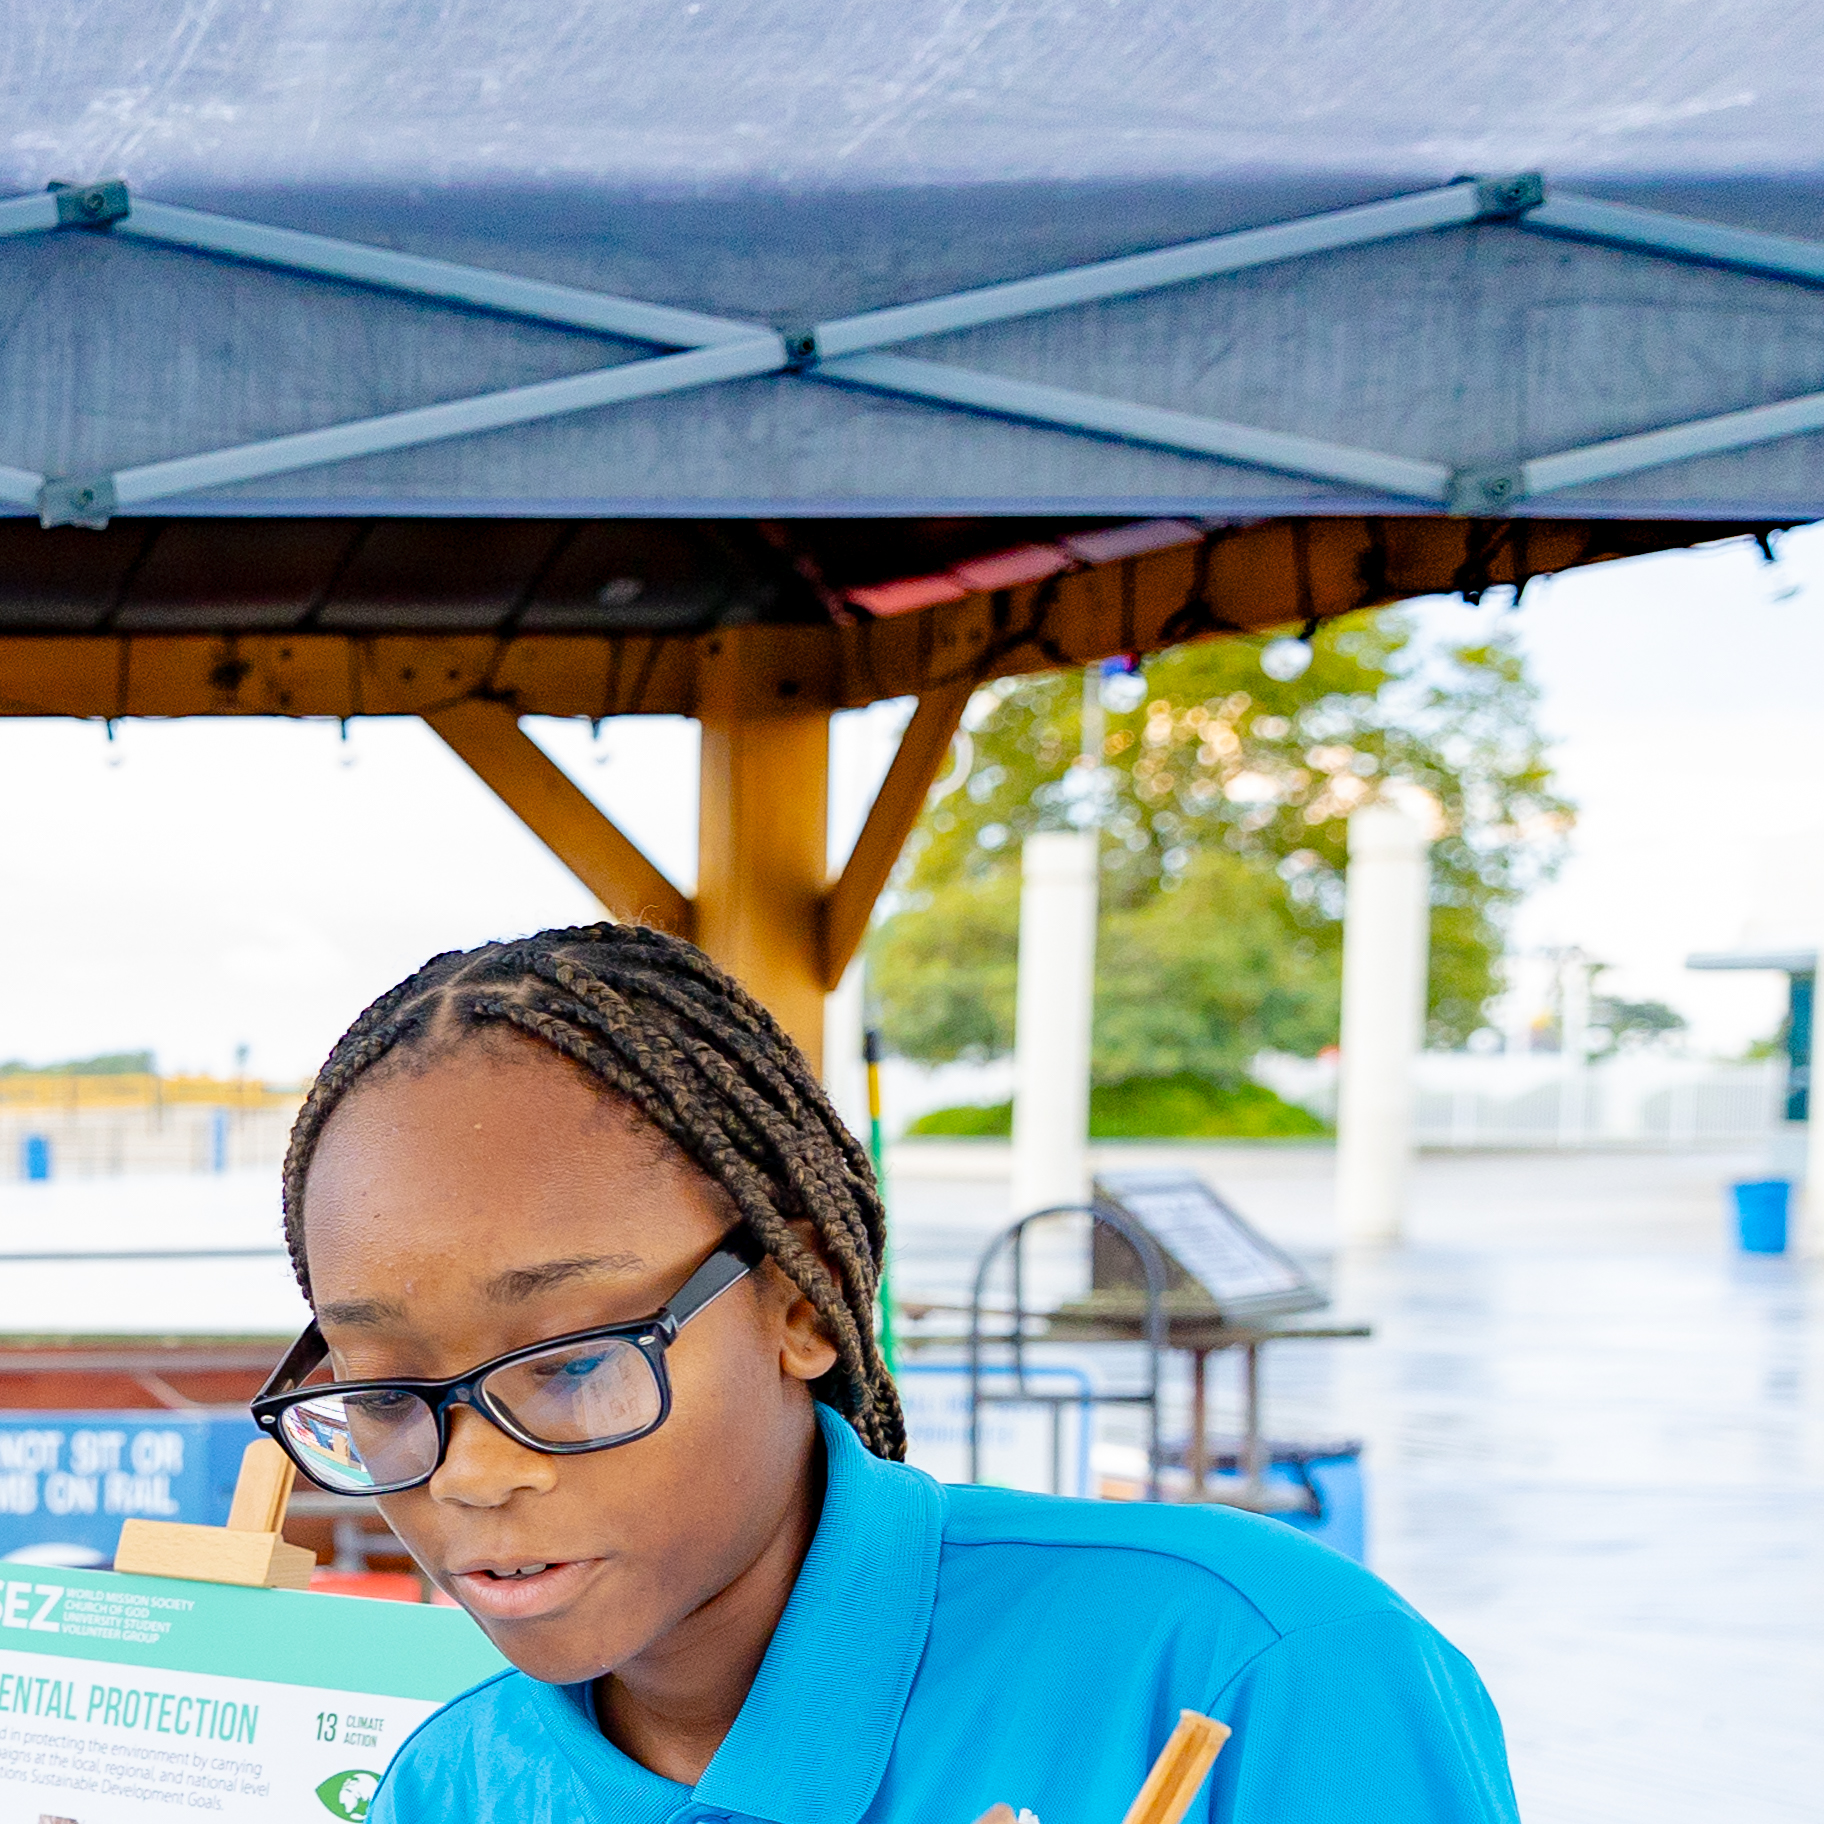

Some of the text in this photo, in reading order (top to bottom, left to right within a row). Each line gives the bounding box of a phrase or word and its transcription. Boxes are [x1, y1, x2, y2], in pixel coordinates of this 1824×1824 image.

[70, 1431, 126, 1474] SIT
[131, 1431, 184, 1475] OR
[45, 1474, 98, 1513] ON
[104, 1473, 180, 1514] RAIL
[64, 1600, 150, 1618] CHURCH OF GOD
[66, 1588, 195, 1611] WORLD MISSION SOCIETY
[61, 1623, 160, 1644] VOLUNTEER GROUP
[63, 1611, 172, 1633] UNIVERSITY STUDENT
[86, 1684, 259, 1745] PROTECTION
[316, 1711, 385, 1742] 13 CLIMATE
[10, 1728, 20, 1741] in
[23, 1730, 85, 1754] protecting
[88, 1739, 108, 1754] the
[111, 1743, 190, 1765] environment
[192, 1752, 208, 1771] by
[211, 1757, 262, 1779] carrying
[343, 1733, 378, 1748] ACTION
[31, 1768, 98, 1792] Sustainable
[101, 1779, 184, 1805] Development
[187, 1792, 224, 1811] Goals.
[34, 1750, 46, 1765] at
[48, 1752, 69, 1768] the
[72, 1756, 101, 1774] local,
[105, 1762, 156, 1782] regional,
[159, 1770, 183, 1784] and
[187, 1772, 237, 1792] national
[240, 1779, 270, 1797] level
